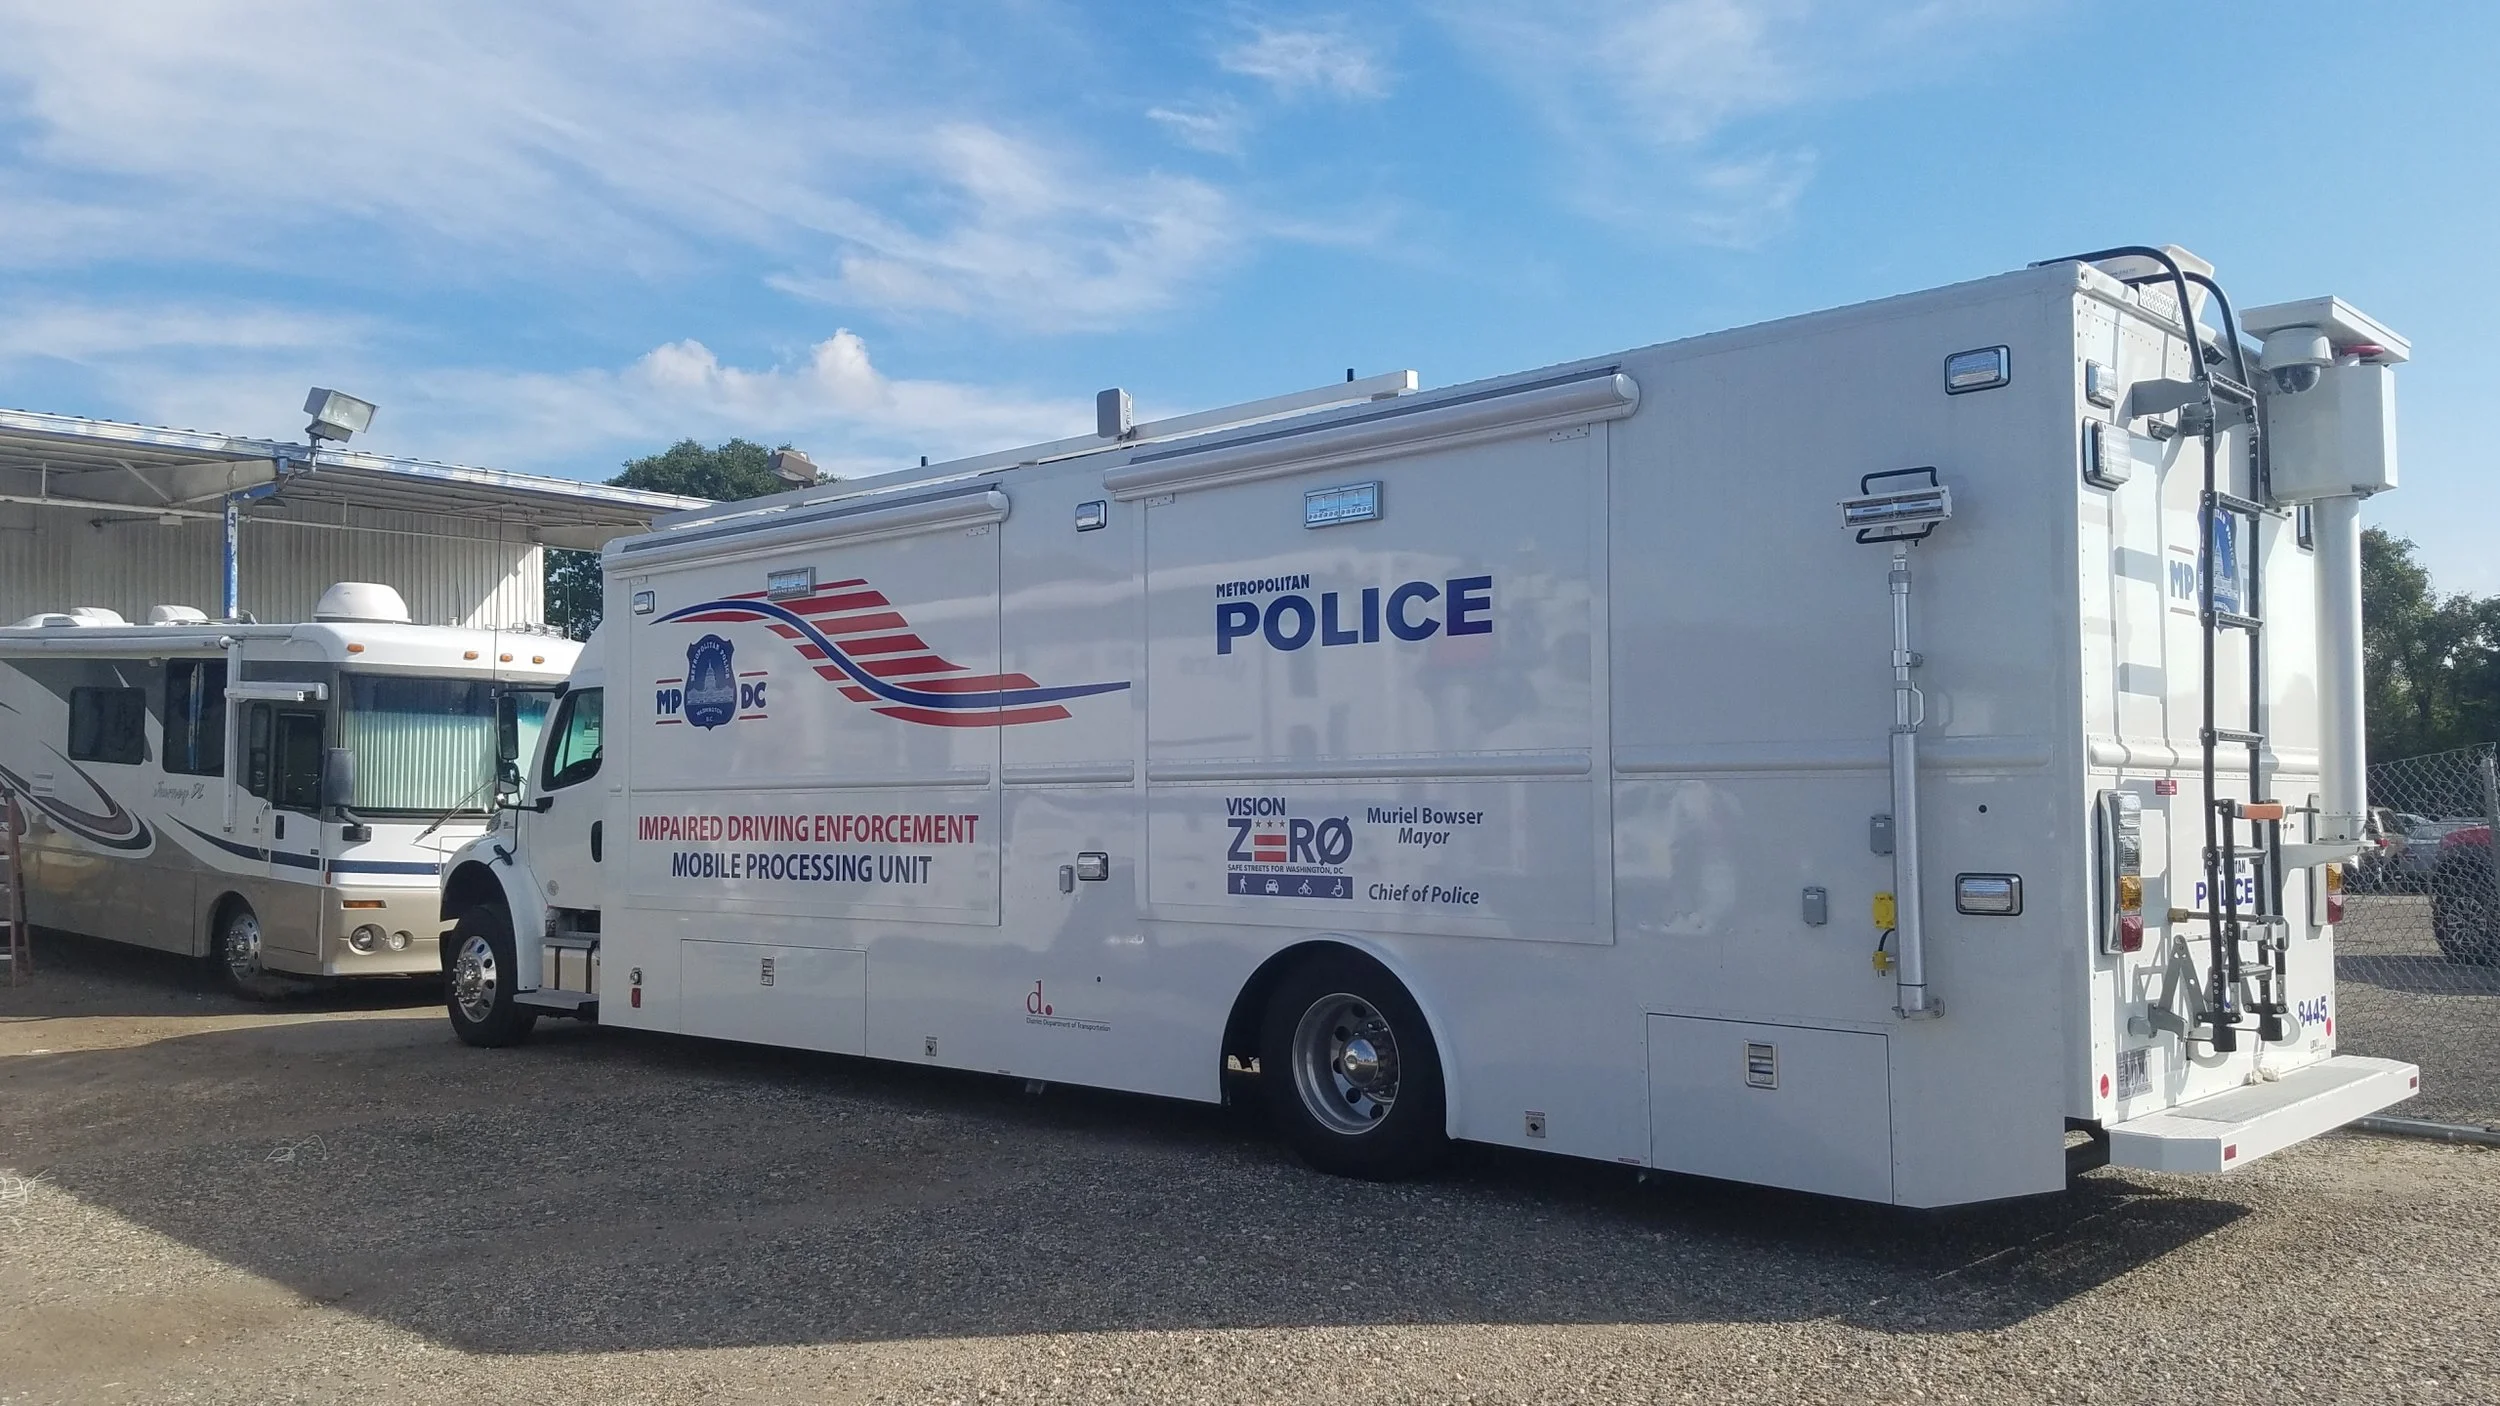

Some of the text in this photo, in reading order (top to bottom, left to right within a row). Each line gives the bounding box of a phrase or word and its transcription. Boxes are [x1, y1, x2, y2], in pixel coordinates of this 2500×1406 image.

[1216, 573, 1310, 598] METROPOLITAN
[2169, 560, 2194, 600] MP
[1216, 575, 1493, 655] POLICE
[690, 641, 731, 682] METROPOLITAN POLICE
[656, 688, 683, 714] MP
[740, 681, 767, 709] DC
[1226, 797, 1286, 817] VISION
[1367, 806, 1484, 825] Muriel Bowser
[638, 815, 980, 844] IMPAIRED DRIVING ENFORCEMENT
[1398, 827, 1451, 849] Mayor
[671, 851, 933, 885] MOBILE PROCESSING UNIT
[1227, 863, 1344, 875] SAFE STREETS FOR WASHINGTON, DC
[1368, 883, 1480, 905] Chief of Police
[2298, 995, 2327, 1028] 8445
